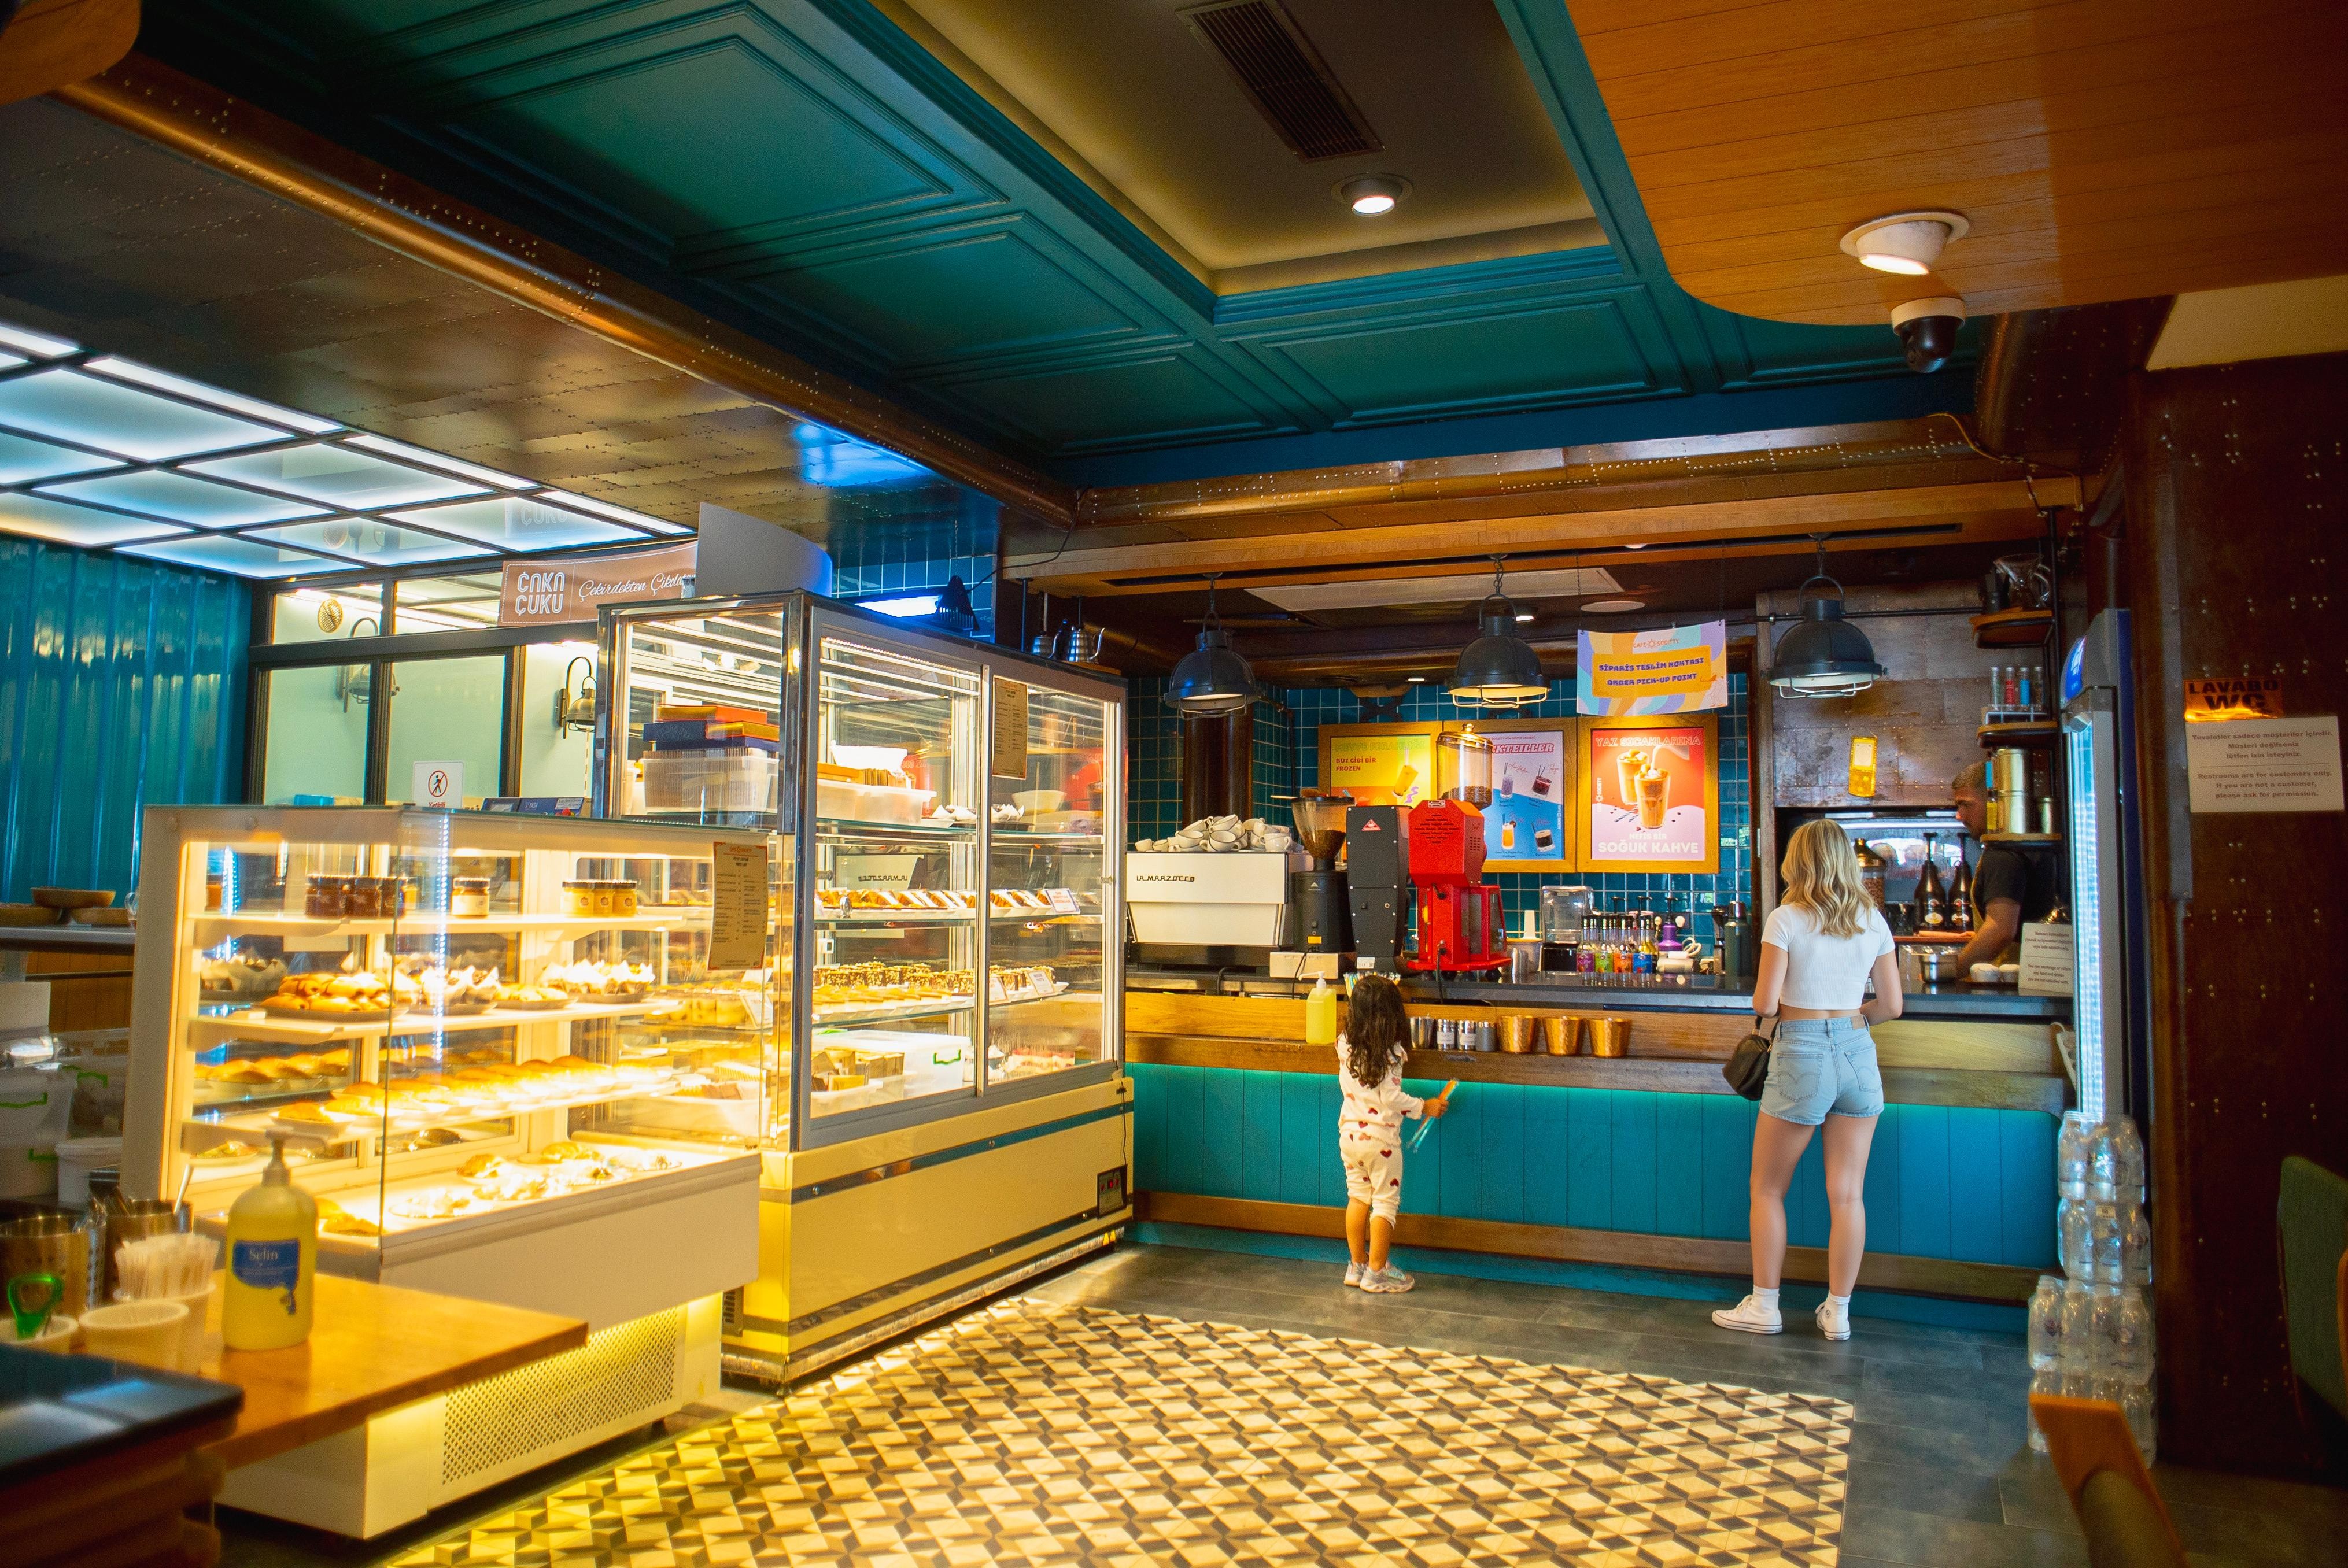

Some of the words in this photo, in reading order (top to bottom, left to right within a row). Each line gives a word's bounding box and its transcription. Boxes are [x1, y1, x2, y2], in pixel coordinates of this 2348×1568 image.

[578, 580, 647, 602] Çekirdekten
[650, 573, 696, 596] Çikola
[515, 594, 564, 616] ÇUKU
[1598, 664, 1634, 672] SİPARİŞ
[1636, 661, 1667, 671] TESLİM
[1668, 657, 1704, 667] NOKTASI
[1636, 676, 1670, 685] PICK-UP
[1672, 673, 1697, 681] POINT
[2188, 679, 2279, 694] LAVABO
[2204, 693, 2266, 710] WC
[1596, 737, 1618, 746] YAZ
[1620, 736, 1701, 746] SICAKLARINA
[1598, 839, 1648, 853] SOĞUK
[1652, 842, 1698, 853] KAHVE
